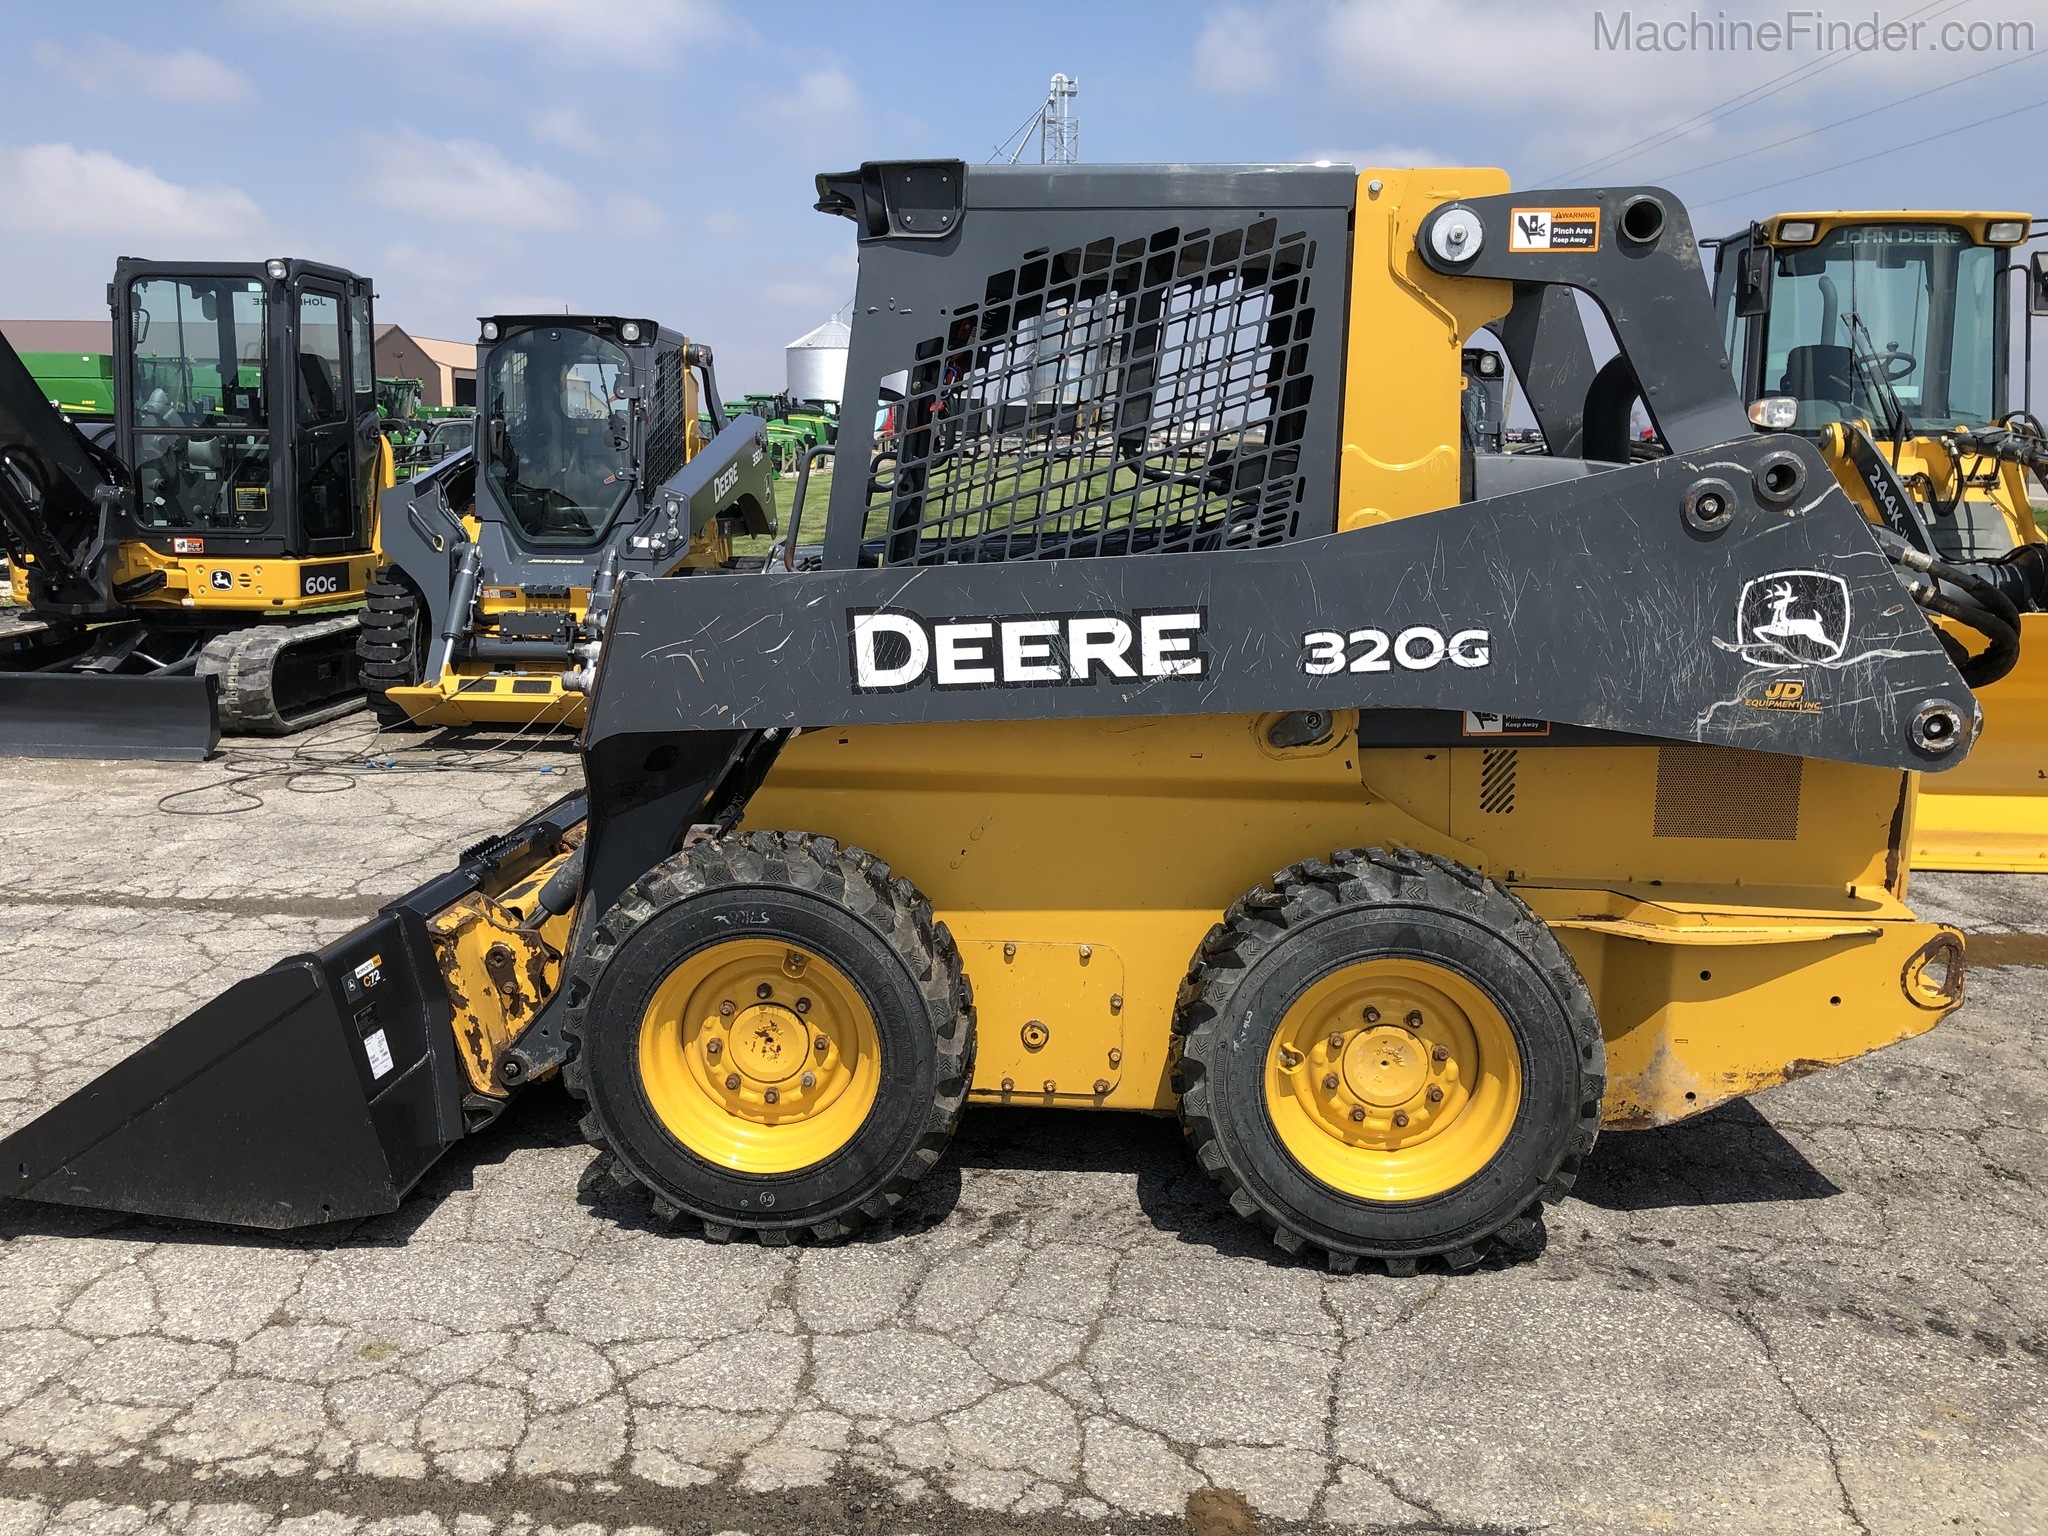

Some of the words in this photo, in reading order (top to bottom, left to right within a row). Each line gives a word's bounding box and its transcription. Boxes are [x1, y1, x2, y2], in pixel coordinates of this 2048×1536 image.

[1562, 211, 1596, 219] WARNING
[1553, 227, 1574, 235] Pinch
[1575, 227, 1593, 235] Area
[1836, 230, 1893, 245] JOHN
[1898, 229, 1961, 244] DEERE
[1552, 236, 1569, 245] Keep
[1569, 236, 1587, 245] Away
[713, 461, 739, 504] DEERE
[305, 575, 337, 594] 60G
[854, 611, 1203, 688] DEERE
[1304, 626, 1490, 675] 320G
[1765, 683, 1804, 699] JD
[1745, 700, 1802, 708] EQUIPMENT
[1505, 722, 1521, 730] Keep
[1522, 722, 1539, 730] Away
[363, 969, 381, 987] C72
